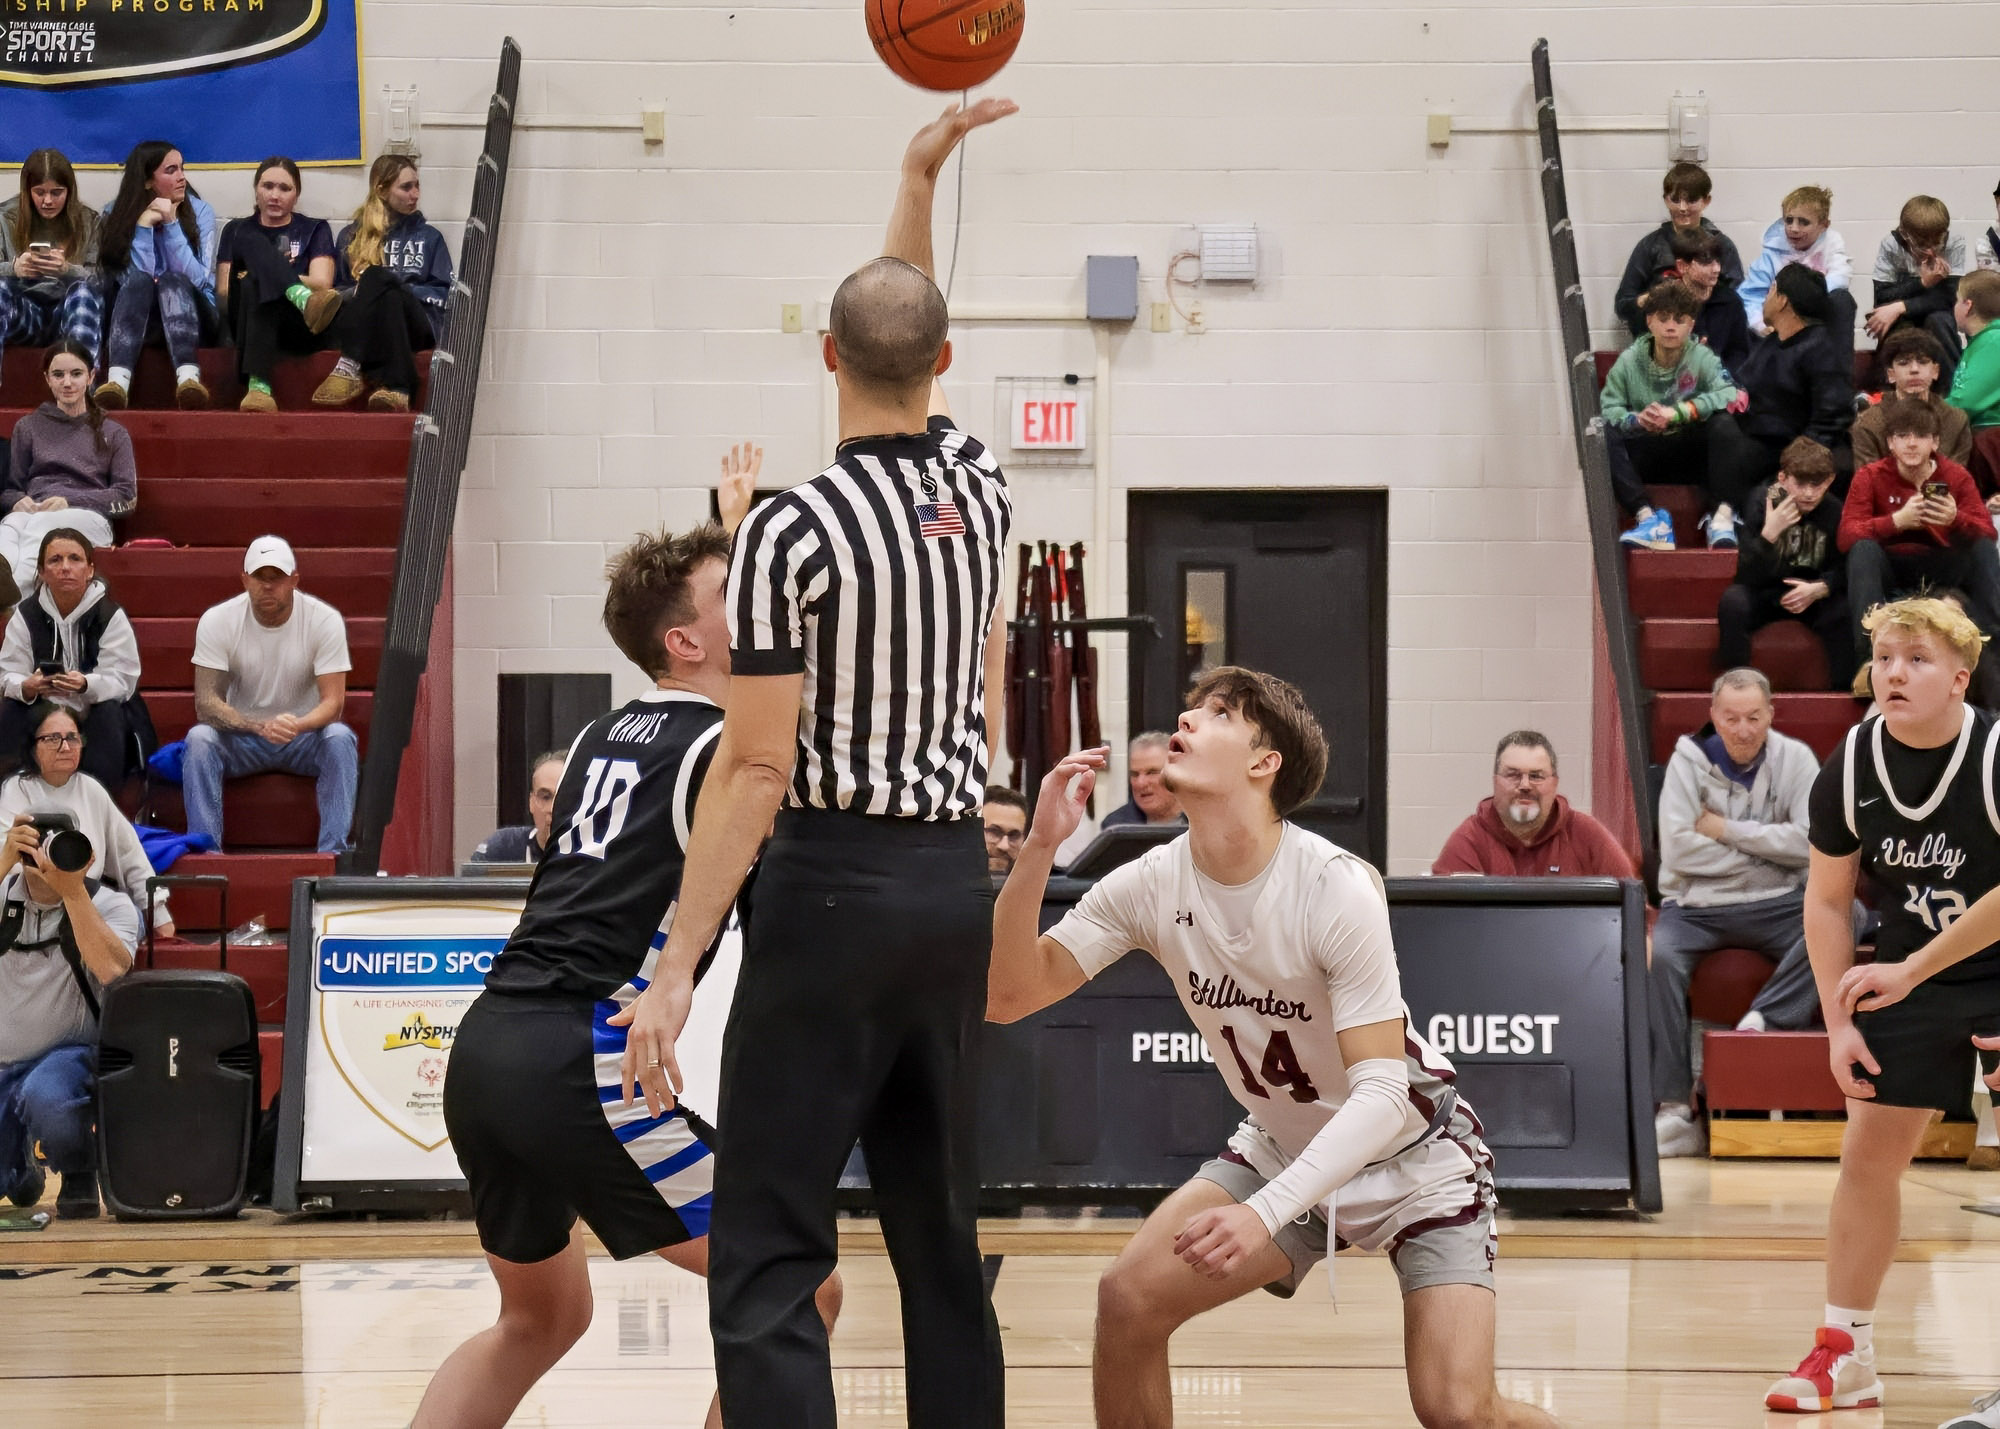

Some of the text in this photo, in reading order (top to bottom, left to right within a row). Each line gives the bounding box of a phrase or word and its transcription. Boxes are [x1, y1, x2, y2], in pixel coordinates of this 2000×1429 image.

[5, 0, 264, 12] SHIP PROGRAM
[9, 21, 95, 31] TIME WARNER CABLE
[7, 30, 96, 51] SPORTS
[6, 51, 94, 63] CHANNEL
[1023, 401, 1077, 443] EXIT
[557, 755, 641, 861] 10
[331, 950, 503, 974] UNIFIED SPO
[353, 1000, 361, 1008] A
[363, 1000, 382, 1008] LIFE
[384, 1000, 442, 1008] CHANGING
[1428, 1014, 1560, 1056] GUEST
[1220, 1025, 1320, 1103] 14
